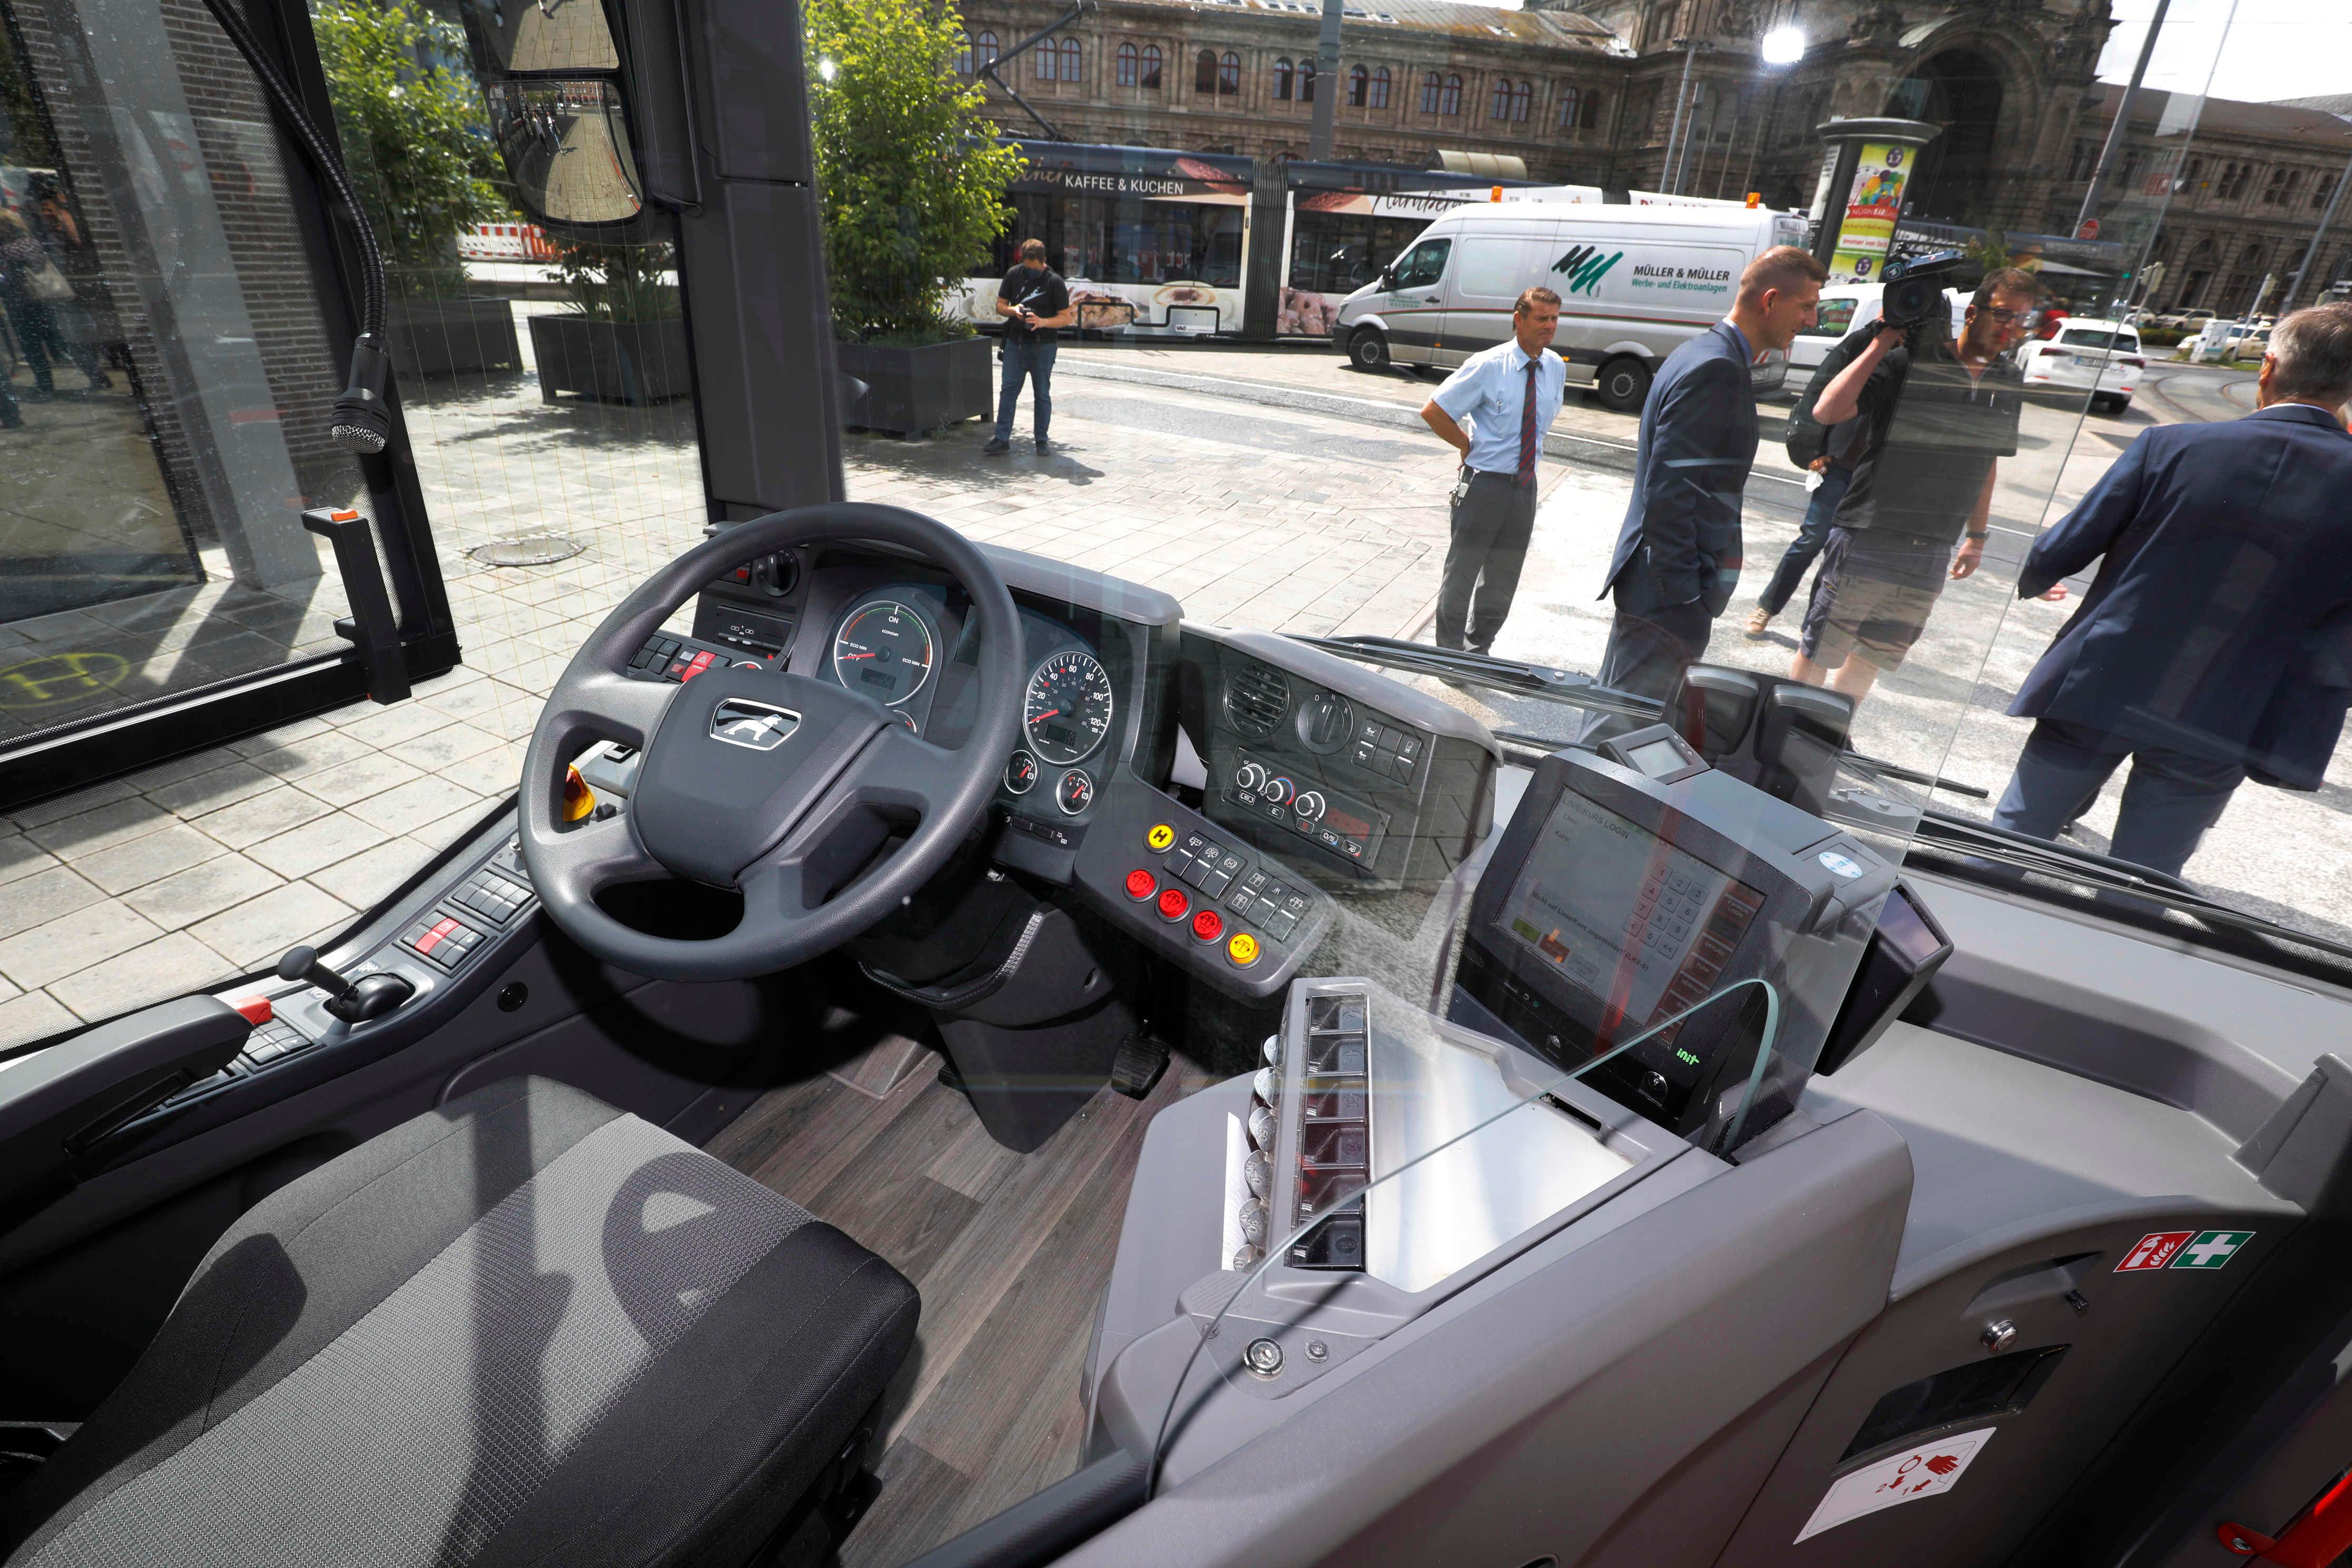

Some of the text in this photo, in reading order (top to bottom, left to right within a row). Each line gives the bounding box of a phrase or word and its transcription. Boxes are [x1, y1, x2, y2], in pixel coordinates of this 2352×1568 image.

[1065, 174, 1114, 191] KAFFEE
[1118, 179, 1126, 191] &
[1131, 179, 1183, 195] KUCHEN
[1634, 264, 1730, 281] MÜLLER & MÜLLER
[1632, 278, 1728, 295] Werbe- und Elektroanlagen
[1093, 692, 1104, 701] 100
[1090, 717, 1101, 727] 120
[1562, 797, 1630, 839] LINIE/KURS LOGIN
[1153, 829, 1168, 842] H
[1531, 890, 1547, 905] Nicht
[1547, 901, 1557, 912] auf
[1676, 1048, 1700, 1065] init
[1875, 1483, 1888, 1494] 2
[1902, 1486, 1910, 1496] 1
